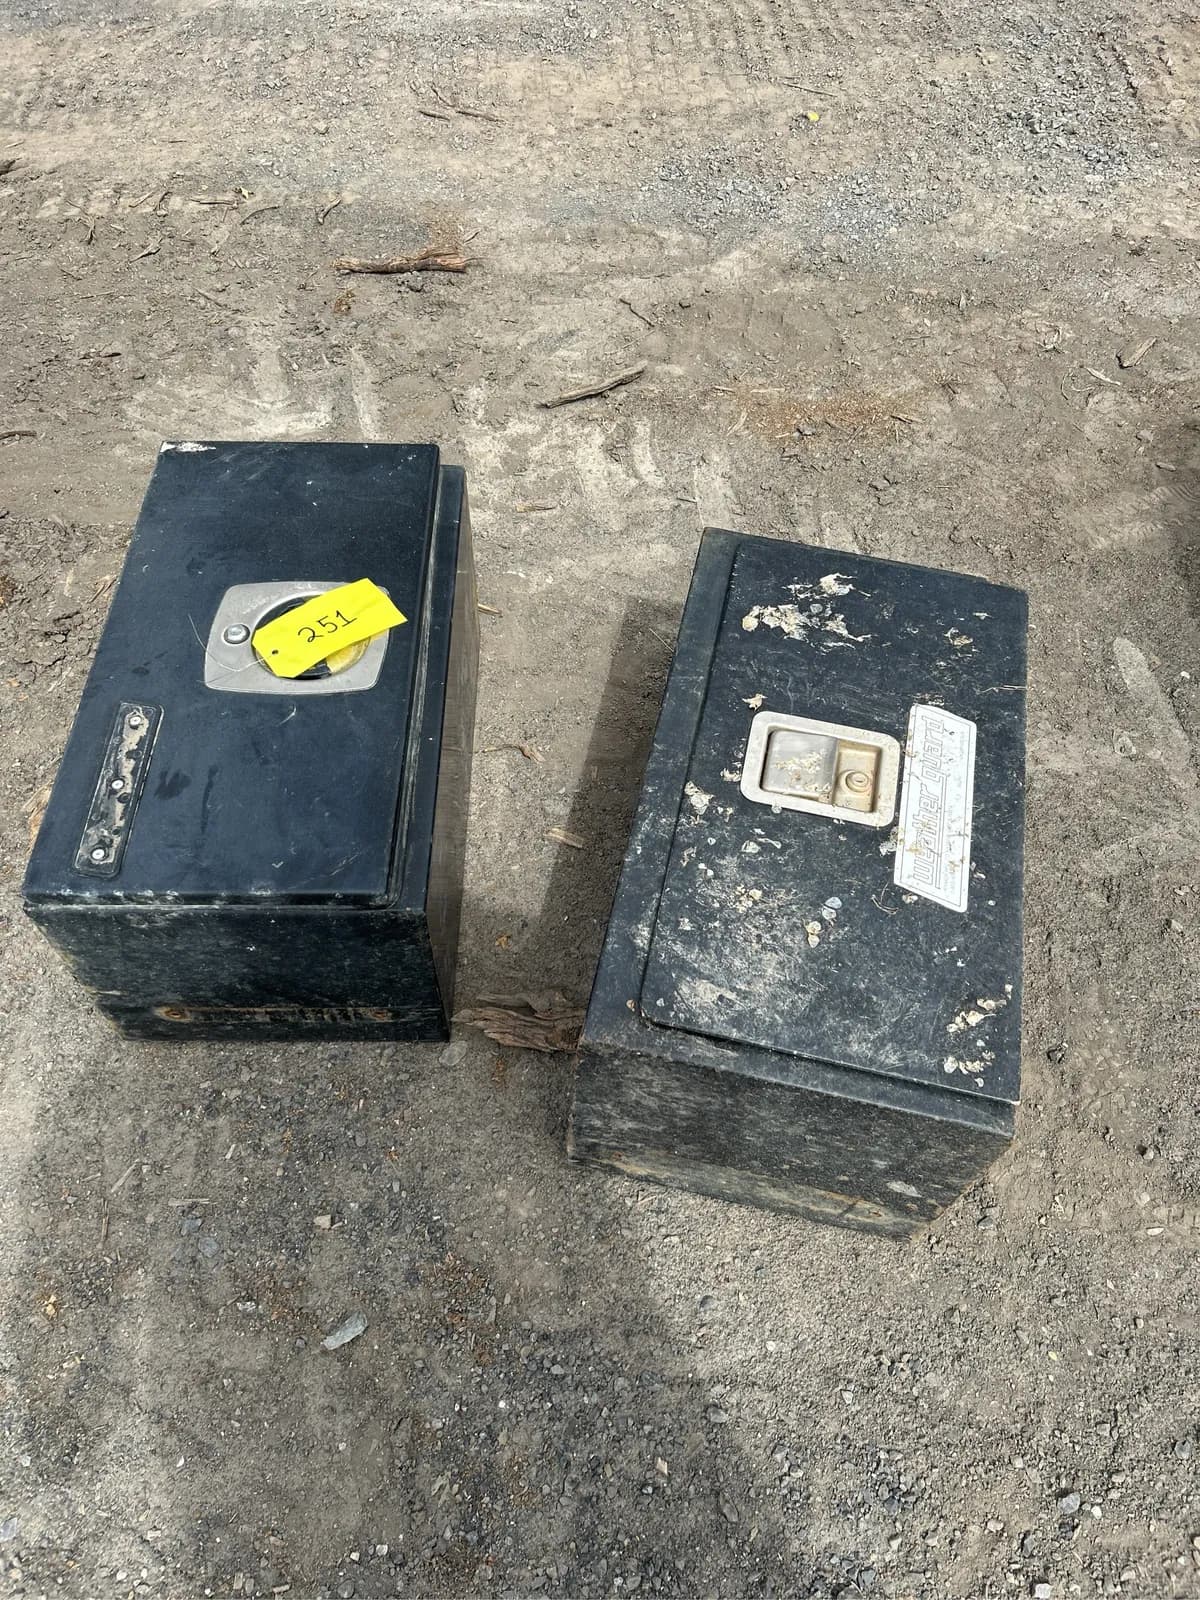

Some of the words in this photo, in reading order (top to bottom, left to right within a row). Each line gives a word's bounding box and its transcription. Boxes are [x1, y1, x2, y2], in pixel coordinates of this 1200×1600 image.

[297, 610, 358, 643] 251
[921, 716, 946, 779] guard
[912, 782, 940, 886] weather
